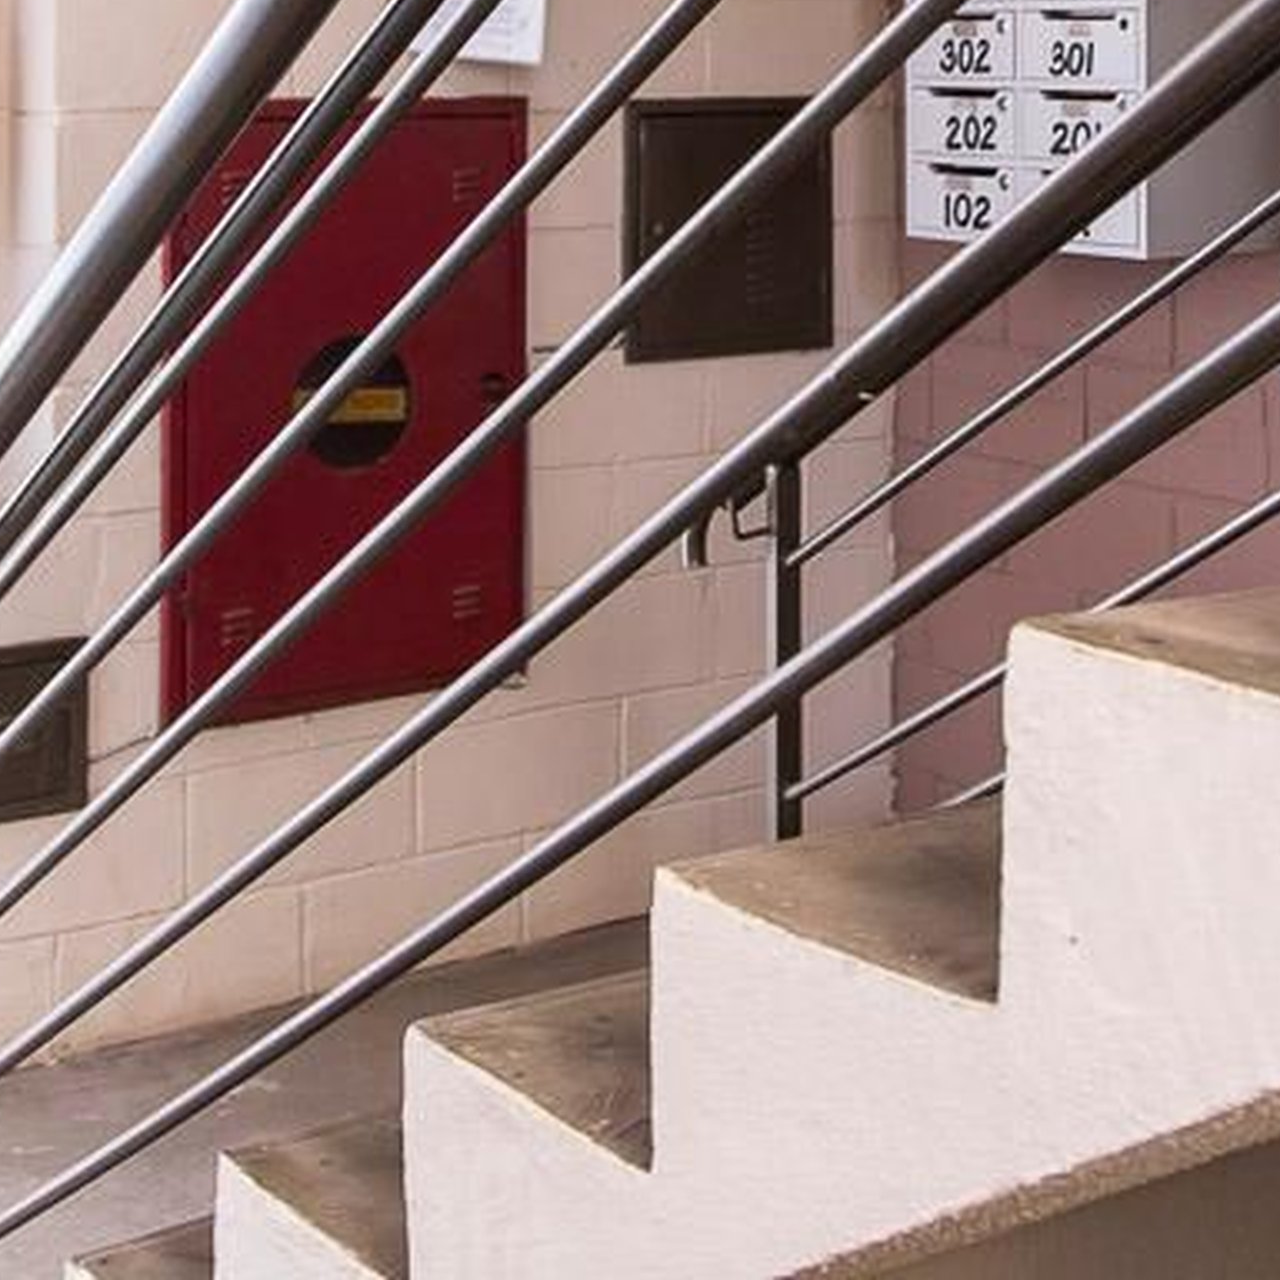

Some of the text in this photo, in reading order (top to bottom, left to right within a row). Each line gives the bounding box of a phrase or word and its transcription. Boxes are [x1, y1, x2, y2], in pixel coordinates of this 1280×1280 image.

[939, 38, 991, 74] 302
[1049, 41, 1095, 77] 301
[946, 115, 997, 150] 202
[944, 193, 991, 230] 102
